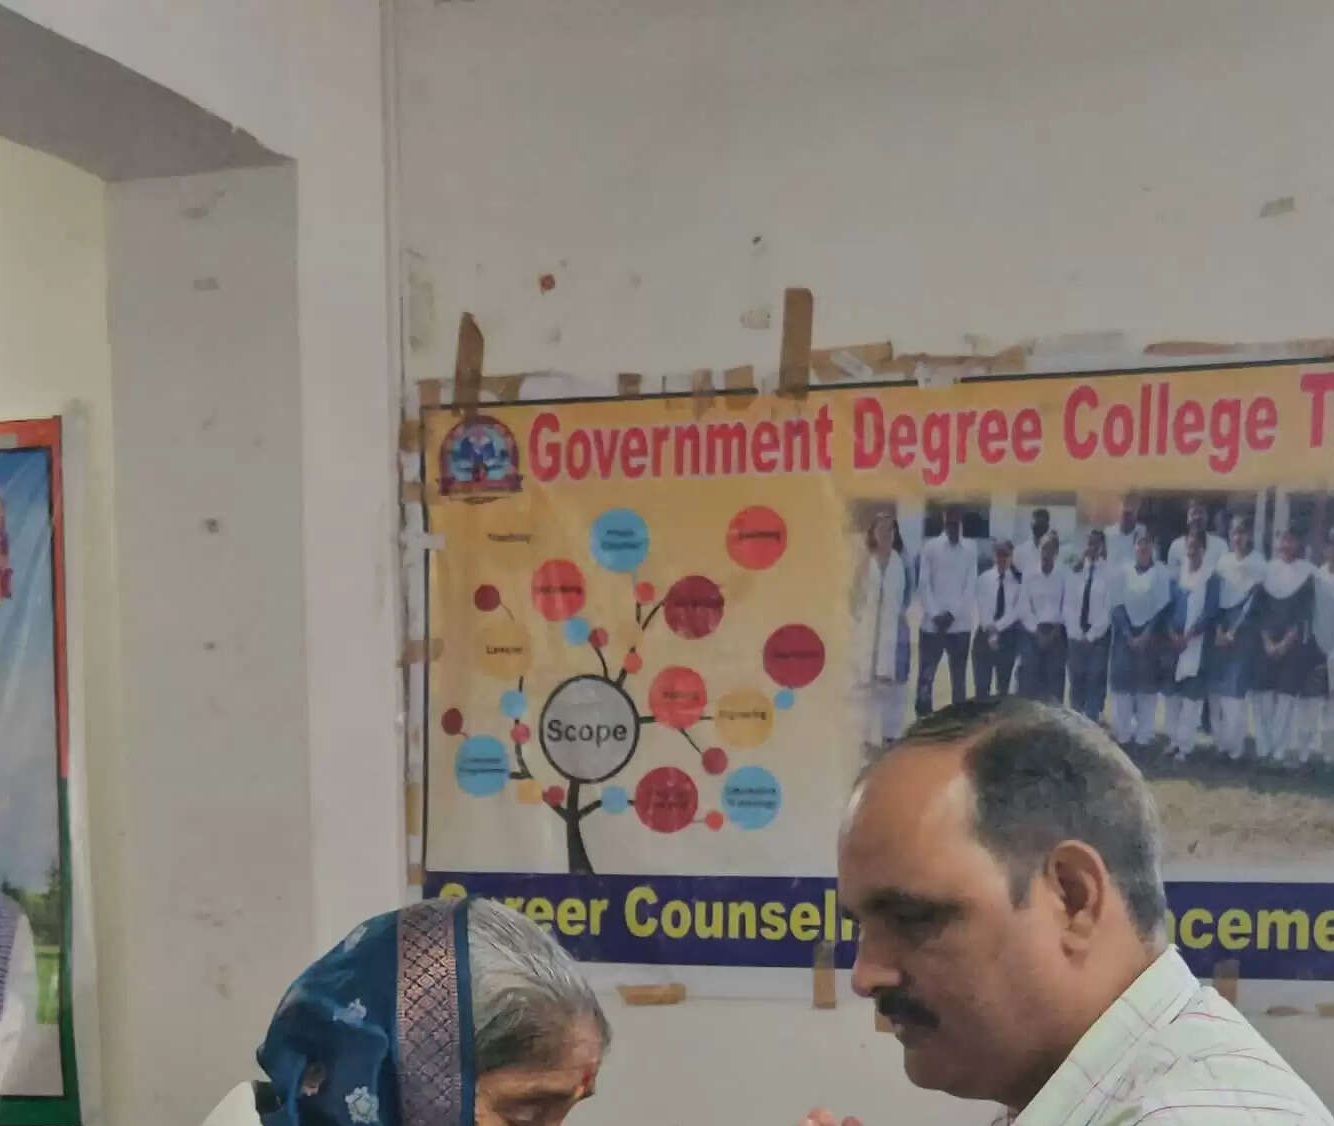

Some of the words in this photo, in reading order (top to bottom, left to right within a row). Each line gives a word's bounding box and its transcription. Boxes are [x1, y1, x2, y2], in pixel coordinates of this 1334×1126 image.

[528, 404, 834, 482] Government
[852, 397, 1042, 487] Degree
[1065, 382, 1278, 474] College
[547, 719, 628, 748] Scope
